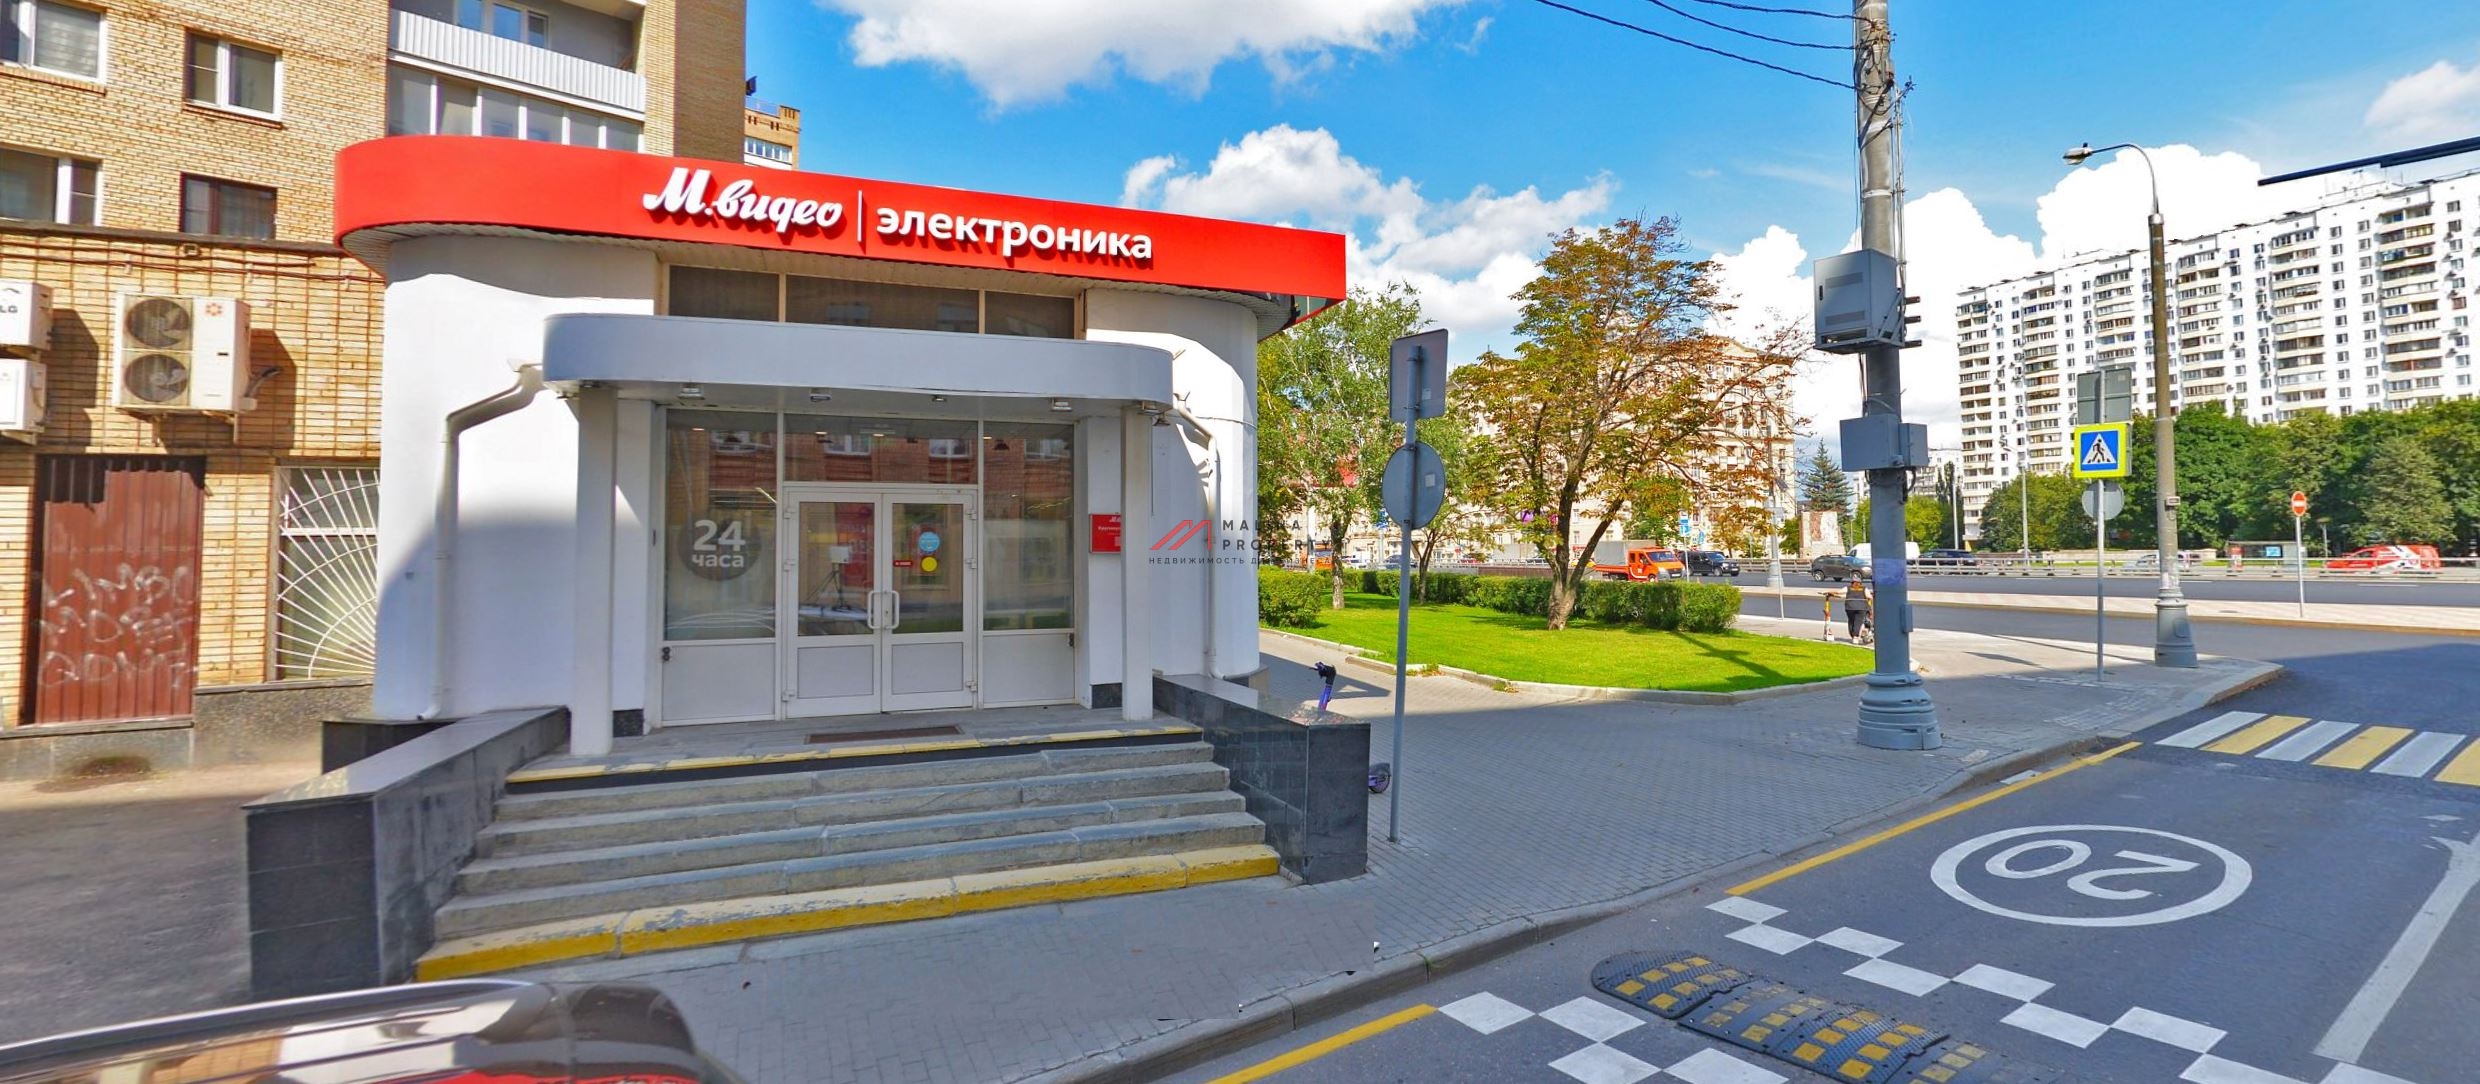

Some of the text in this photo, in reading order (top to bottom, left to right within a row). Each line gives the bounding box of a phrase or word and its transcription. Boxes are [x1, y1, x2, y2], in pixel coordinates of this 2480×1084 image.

[643, 167, 1153, 260] М.видео электроника
[694, 519, 747, 551] 24
[691, 552, 745, 568] часа
[1985, 839, 2200, 900] 20
